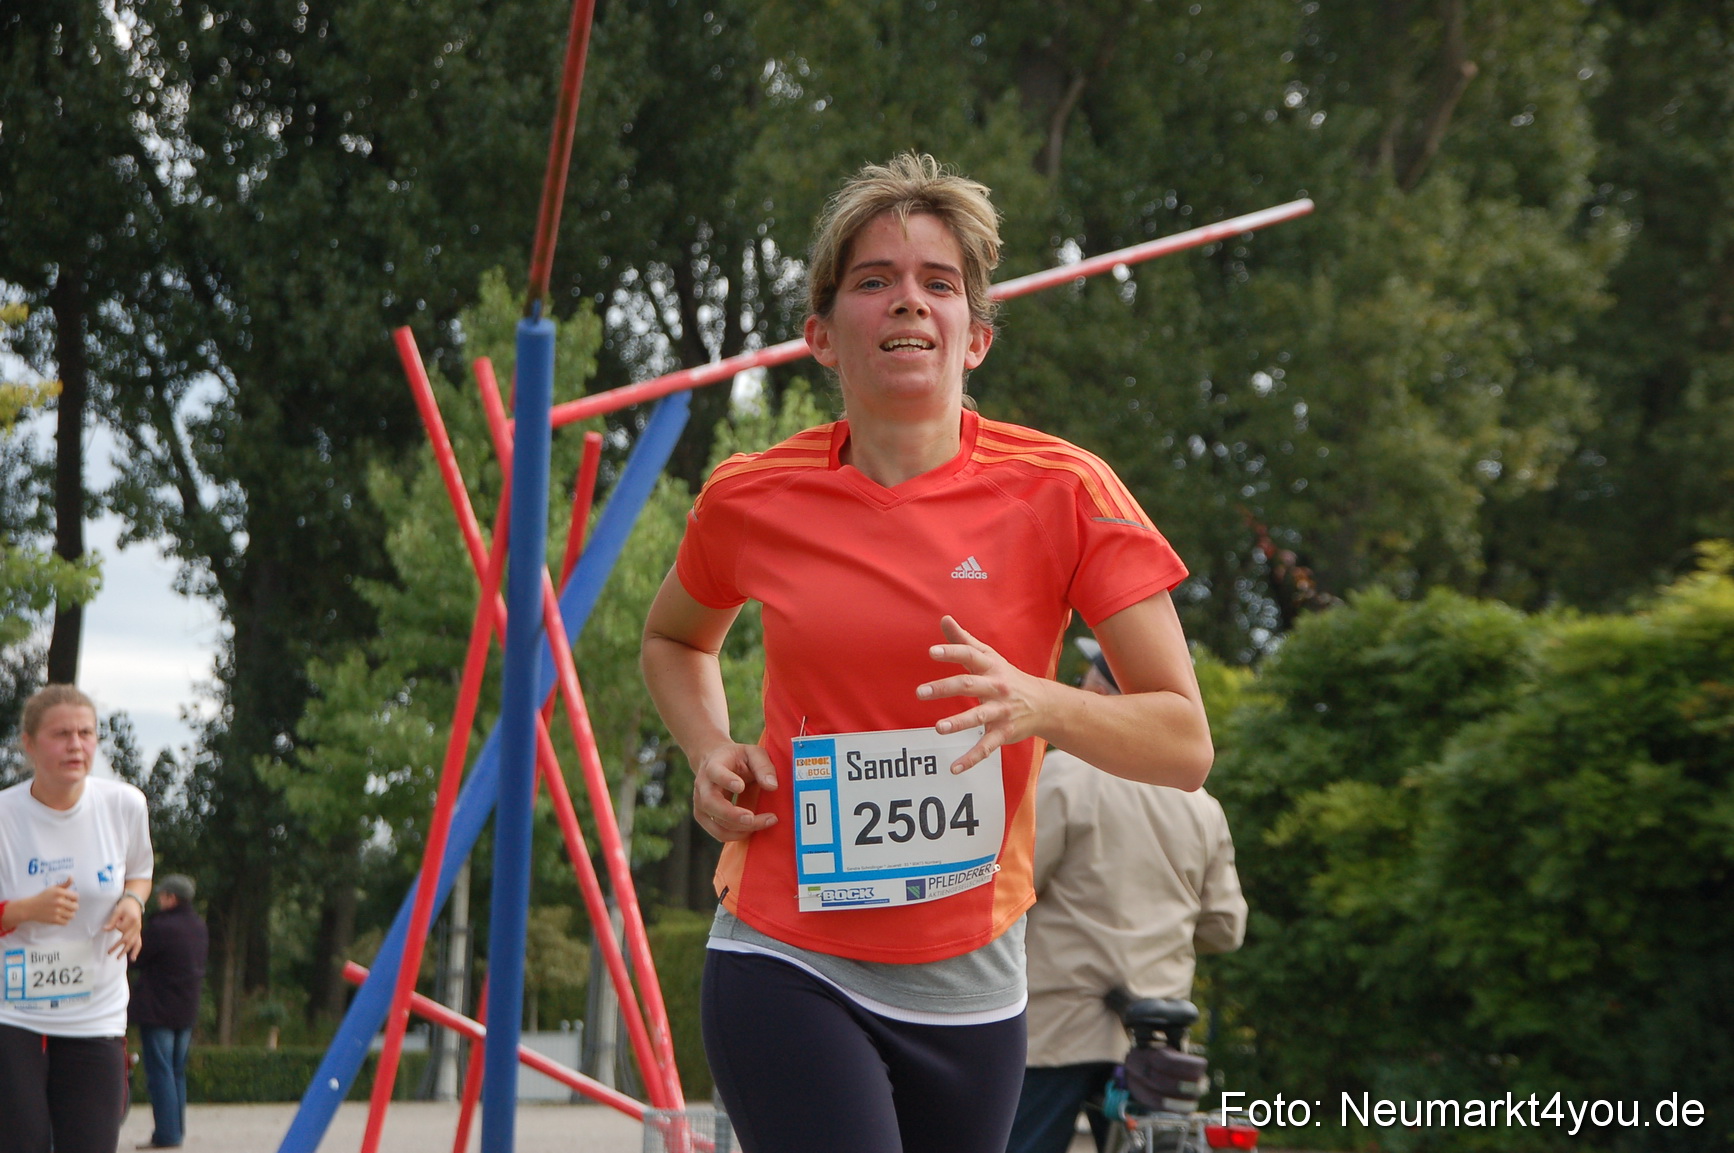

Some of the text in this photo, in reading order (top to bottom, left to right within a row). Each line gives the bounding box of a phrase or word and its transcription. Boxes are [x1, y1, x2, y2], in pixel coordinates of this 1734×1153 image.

[951, 570, 988, 579] adidas
[847, 748, 937, 781] Sandra
[806, 803, 817, 825] D
[853, 792, 979, 846] 2504
[928, 863, 992, 890] PFLEIDERER
[821, 887, 875, 902] BOCK
[31, 951, 60, 964] Birgit
[33, 966, 84, 988] 2462
